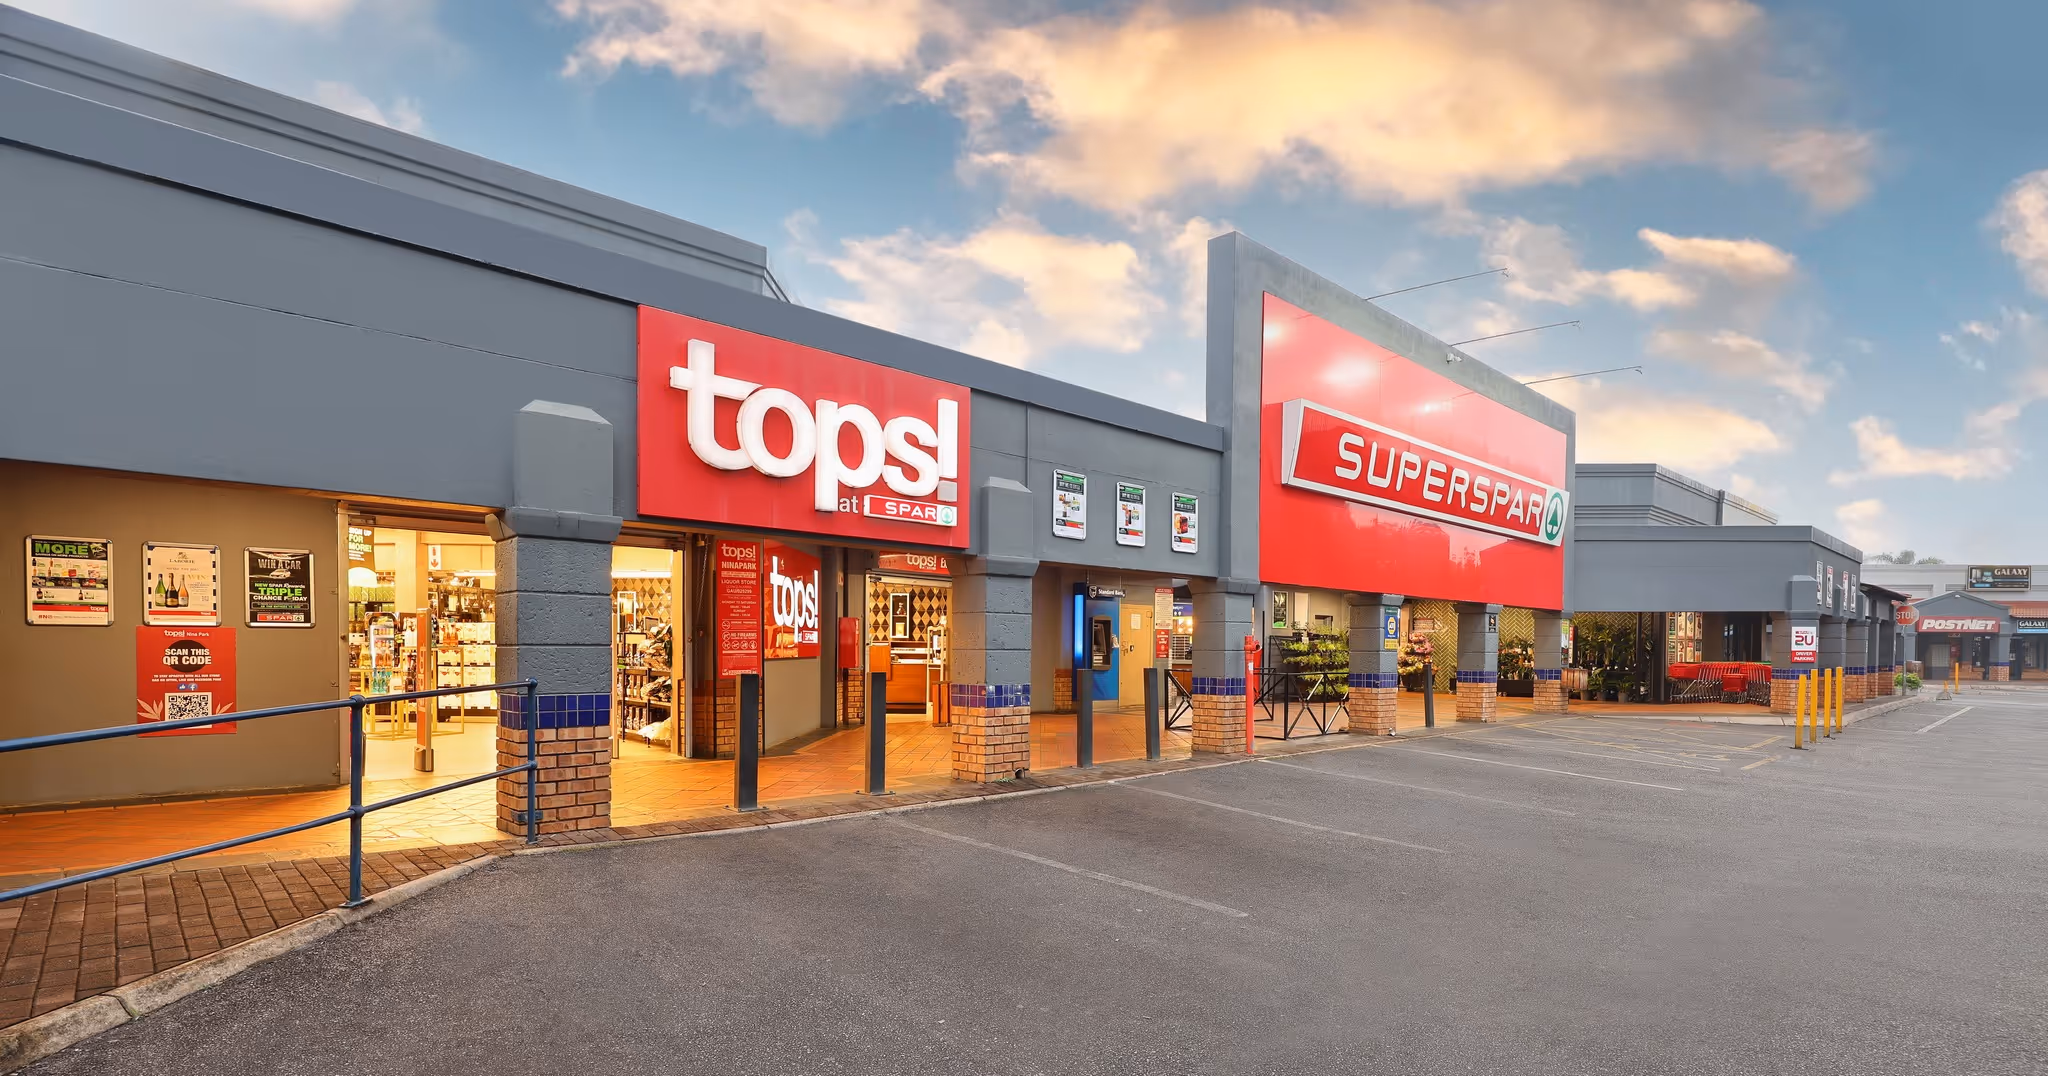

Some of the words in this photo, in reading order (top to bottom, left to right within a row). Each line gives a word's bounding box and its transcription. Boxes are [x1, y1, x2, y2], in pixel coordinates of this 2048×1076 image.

[669, 338, 959, 512] tops!
[1334, 432, 1544, 528] SUPERSPAR
[839, 495, 859, 514] at
[885, 501, 937, 520] SPAR
[348, 534, 364, 544] FOR
[34, 542, 89, 556] MORE
[721, 543, 756, 560] tops!
[258, 558, 276, 569] WIN
[278, 560, 284, 570] A
[285, 560, 302, 570] CAR
[721, 561, 757, 570] NINAPARK
[906, 553, 937, 569] tops!
[1994, 568, 2028, 576] GALAXY
[258, 587, 302, 597] TRIPLE
[770, 555, 818, 644] tops!
[1896, 611, 1916, 620] STOP
[1922, 619, 1996, 630] POSTNET
[164, 630, 185, 638] tops!
[162, 656, 179, 665] QR
[182, 656, 212, 665] CODE
